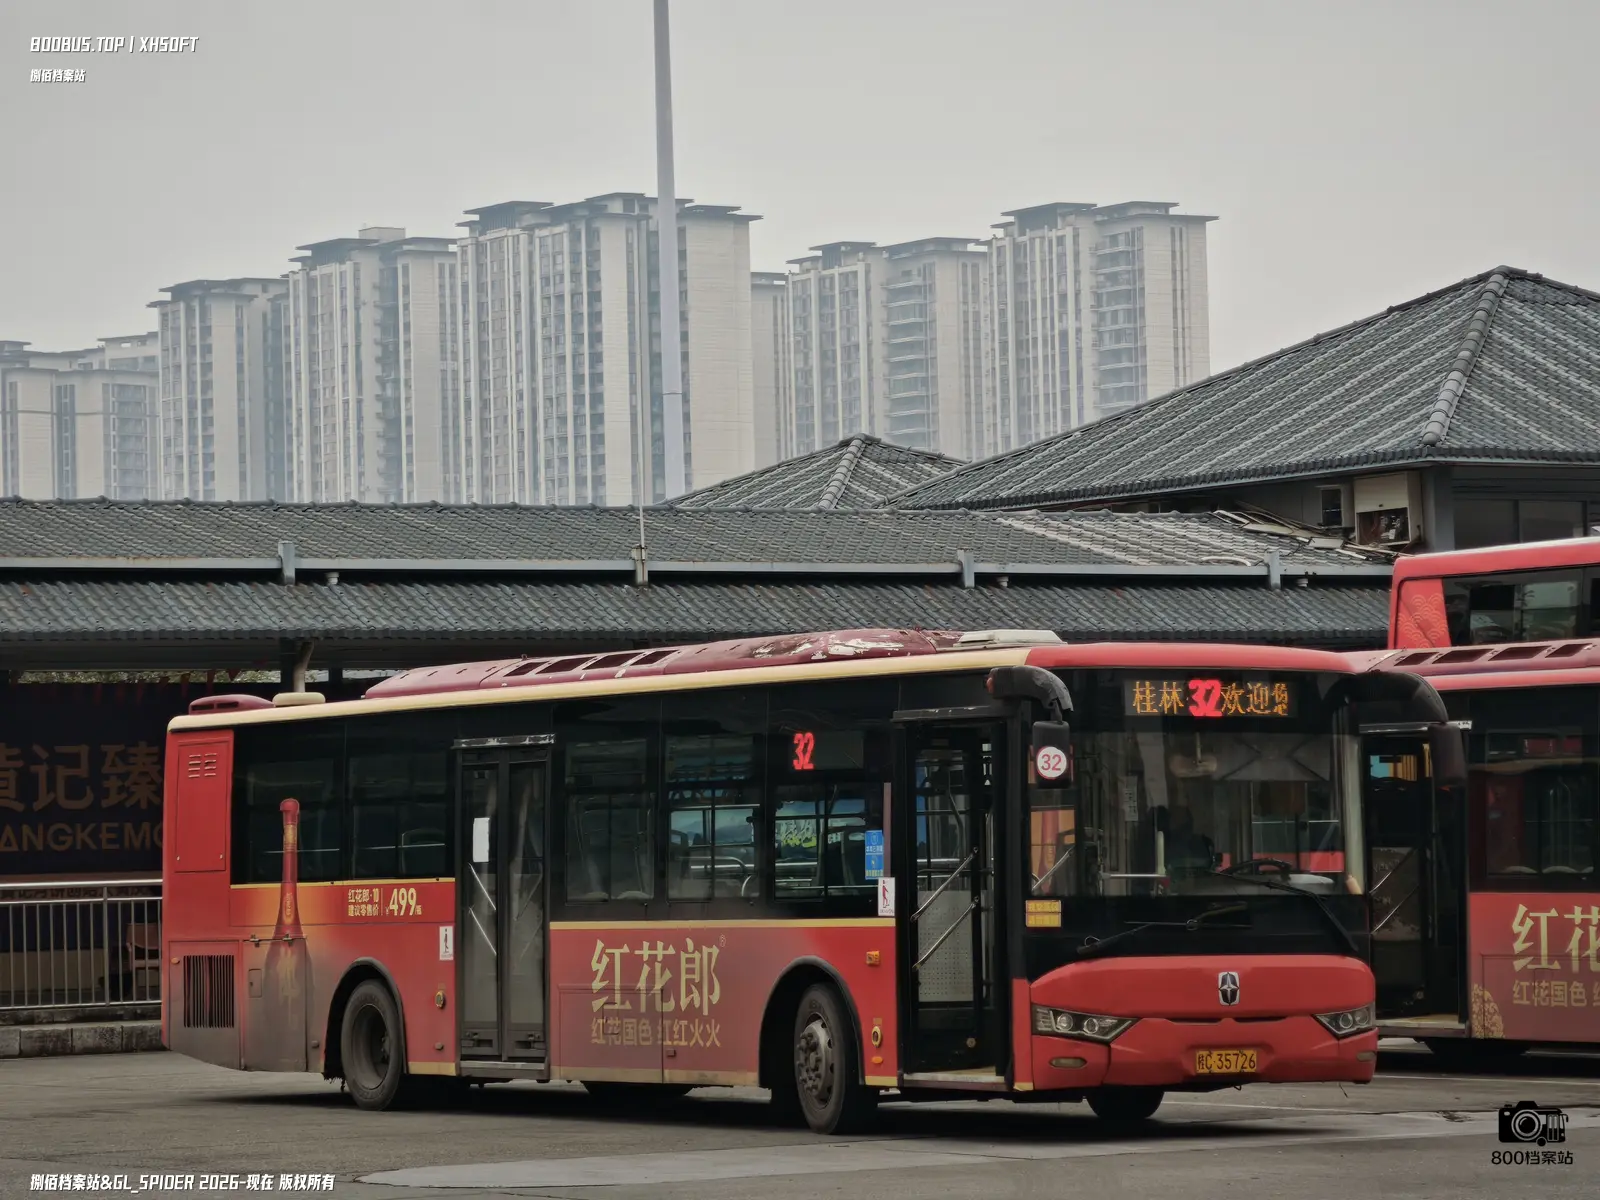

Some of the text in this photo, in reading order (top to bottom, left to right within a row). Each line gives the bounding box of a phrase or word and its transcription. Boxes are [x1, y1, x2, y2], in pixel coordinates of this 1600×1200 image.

[1132, 681, 1184, 715] 桂林
[1188, 679, 1223, 717] 32
[793, 732, 815, 770] 32
[1041, 753, 1062, 771] 32
[591, 937, 721, 1016] 红花郎
[591, 1016, 721, 1048] 红花国色 红红火火
